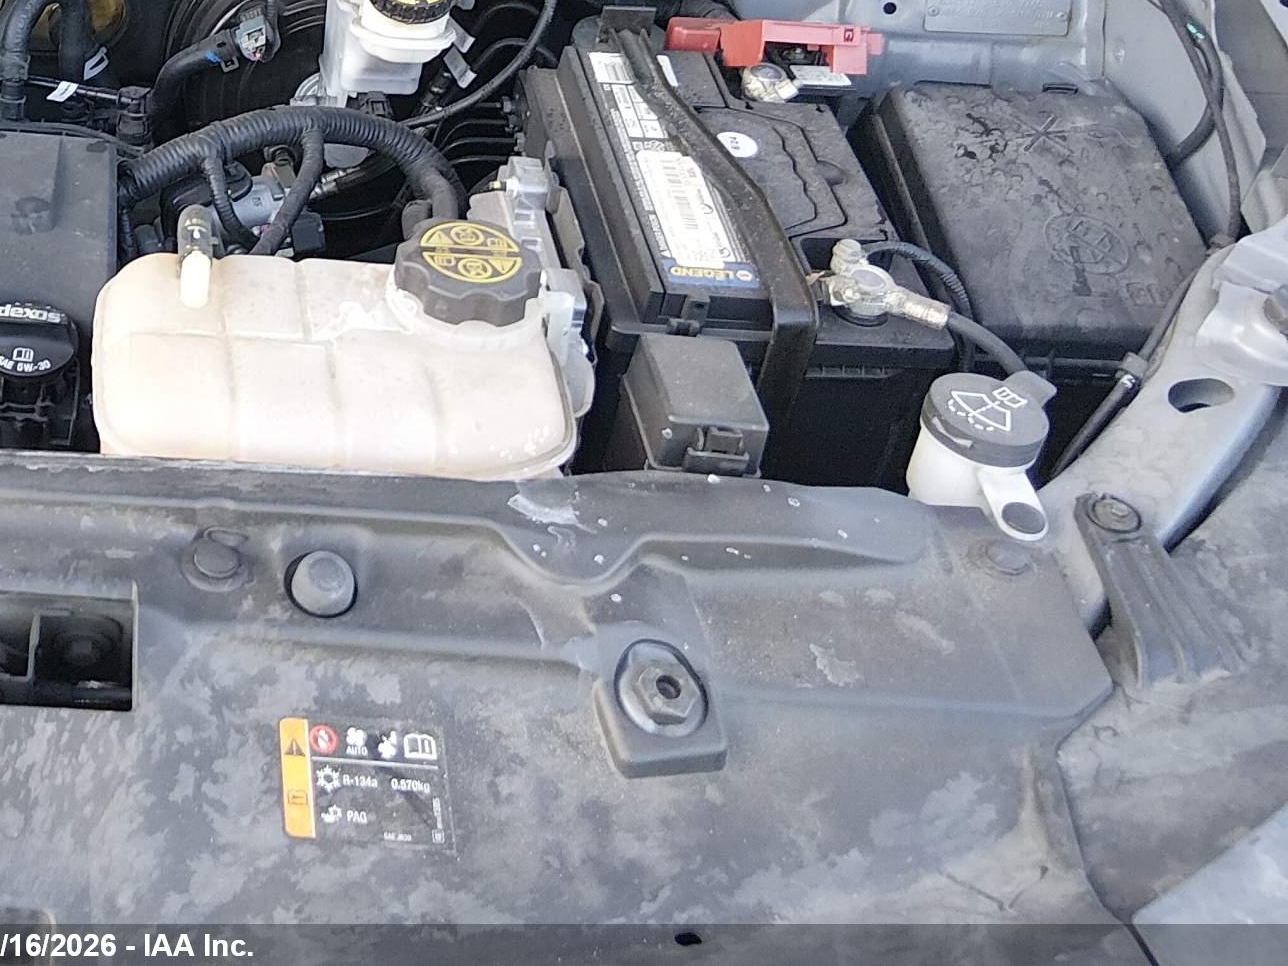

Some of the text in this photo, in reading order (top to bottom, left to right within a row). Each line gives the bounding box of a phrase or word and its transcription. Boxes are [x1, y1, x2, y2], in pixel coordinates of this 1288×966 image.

[669, 265, 734, 281] LEGEND
[345, 746, 368, 756] AUTO
[342, 774, 378, 789] R-134a
[346, 810, 368, 824] PAG
